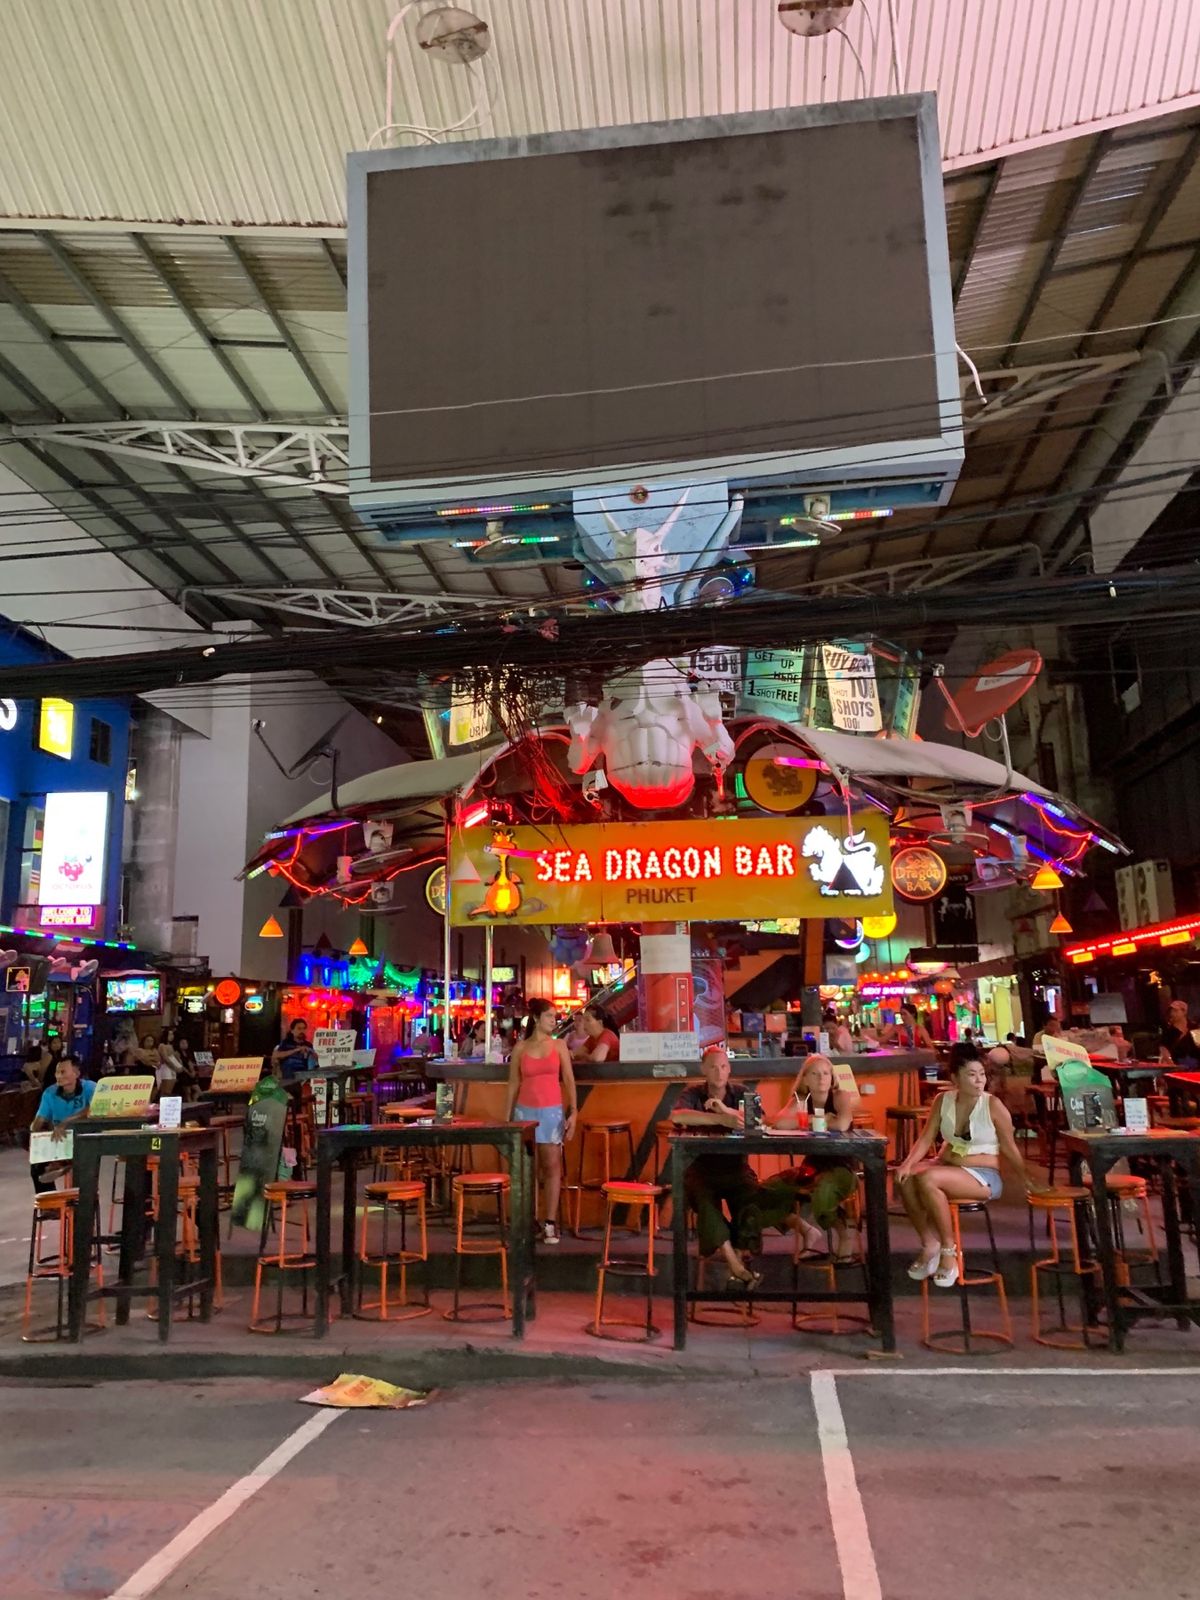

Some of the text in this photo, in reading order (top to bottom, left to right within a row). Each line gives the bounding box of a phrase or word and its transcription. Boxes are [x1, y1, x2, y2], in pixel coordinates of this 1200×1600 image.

[755, 651, 774, 661] GET
[781, 659, 795, 669] UP
[757, 689, 775, 699] SHOT
[776, 689, 799, 702] FREE
[836, 699, 875, 718] SHOTS
[536, 843, 794, 882] SEA DRAGON BAR
[626, 886, 697, 904] PHUKET
[152, 1137, 160, 1149] 4
